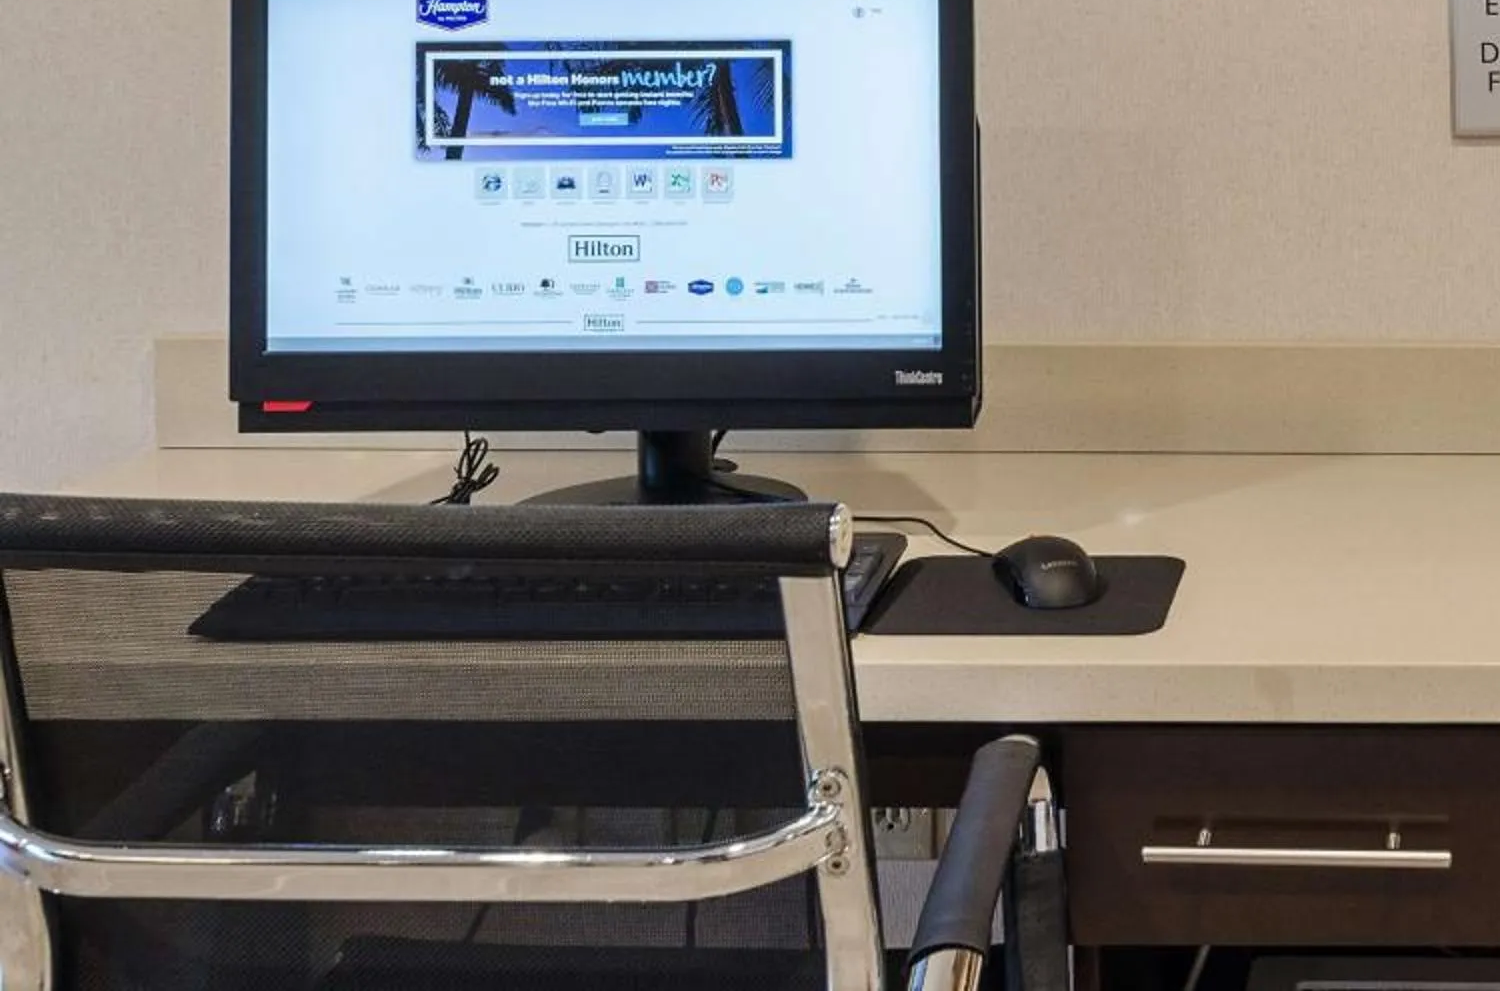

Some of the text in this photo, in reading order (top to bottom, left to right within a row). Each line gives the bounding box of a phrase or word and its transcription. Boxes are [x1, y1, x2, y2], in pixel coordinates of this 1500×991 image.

[489, 61, 717, 88] not a Hilton Honors member?
[574, 240, 634, 257] Hilton
